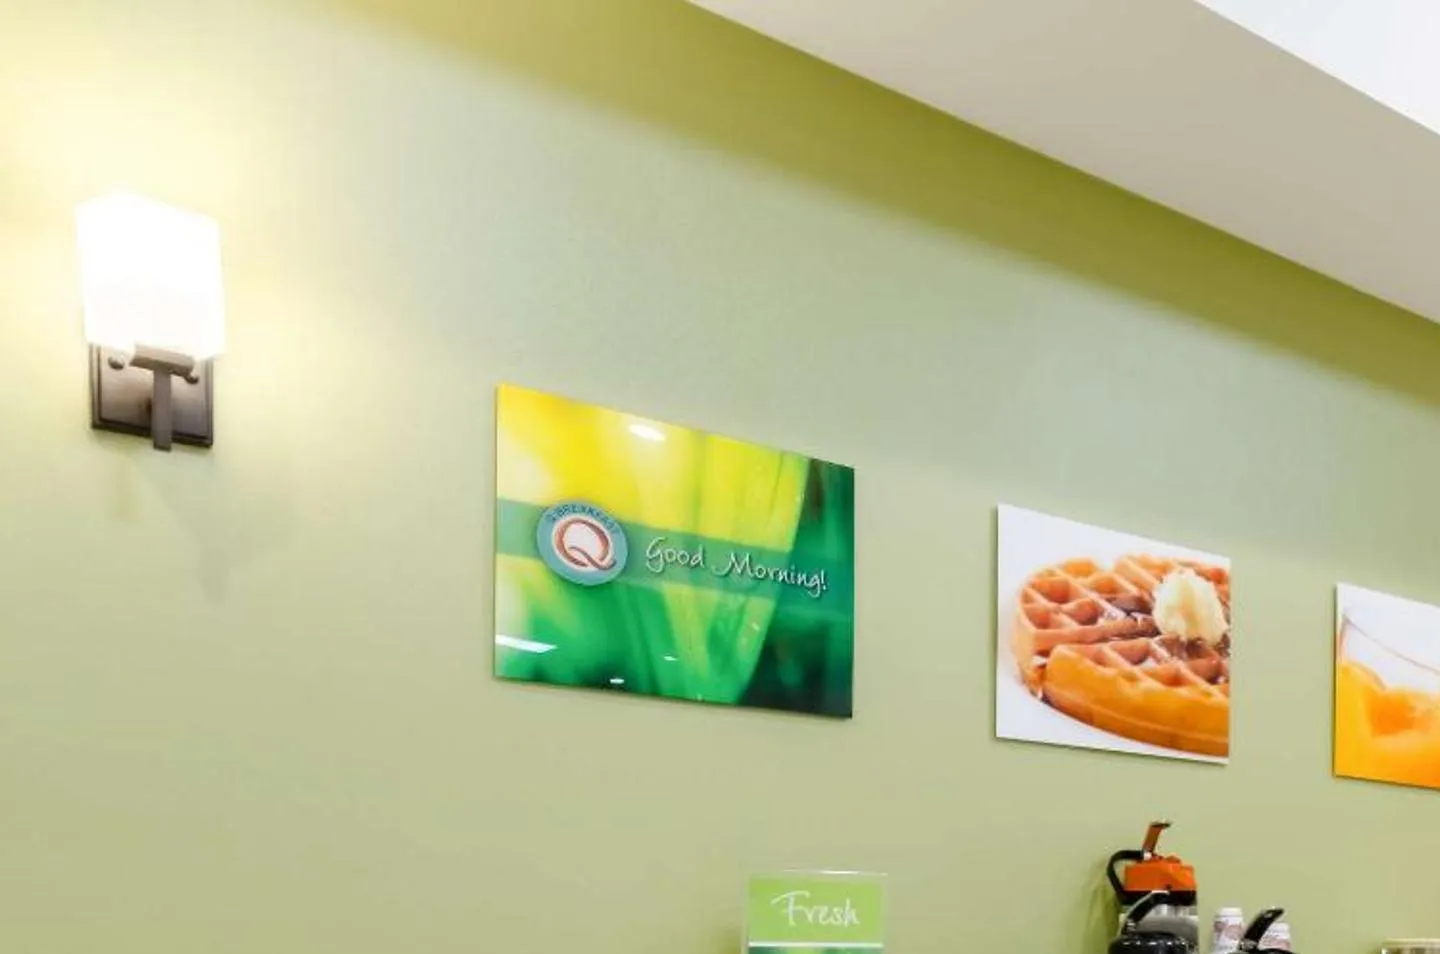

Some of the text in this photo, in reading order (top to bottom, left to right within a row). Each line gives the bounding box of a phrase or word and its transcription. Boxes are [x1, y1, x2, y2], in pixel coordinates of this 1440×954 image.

[645, 536, 827, 598] Good Morning!
[769, 889, 861, 929] Fresh
